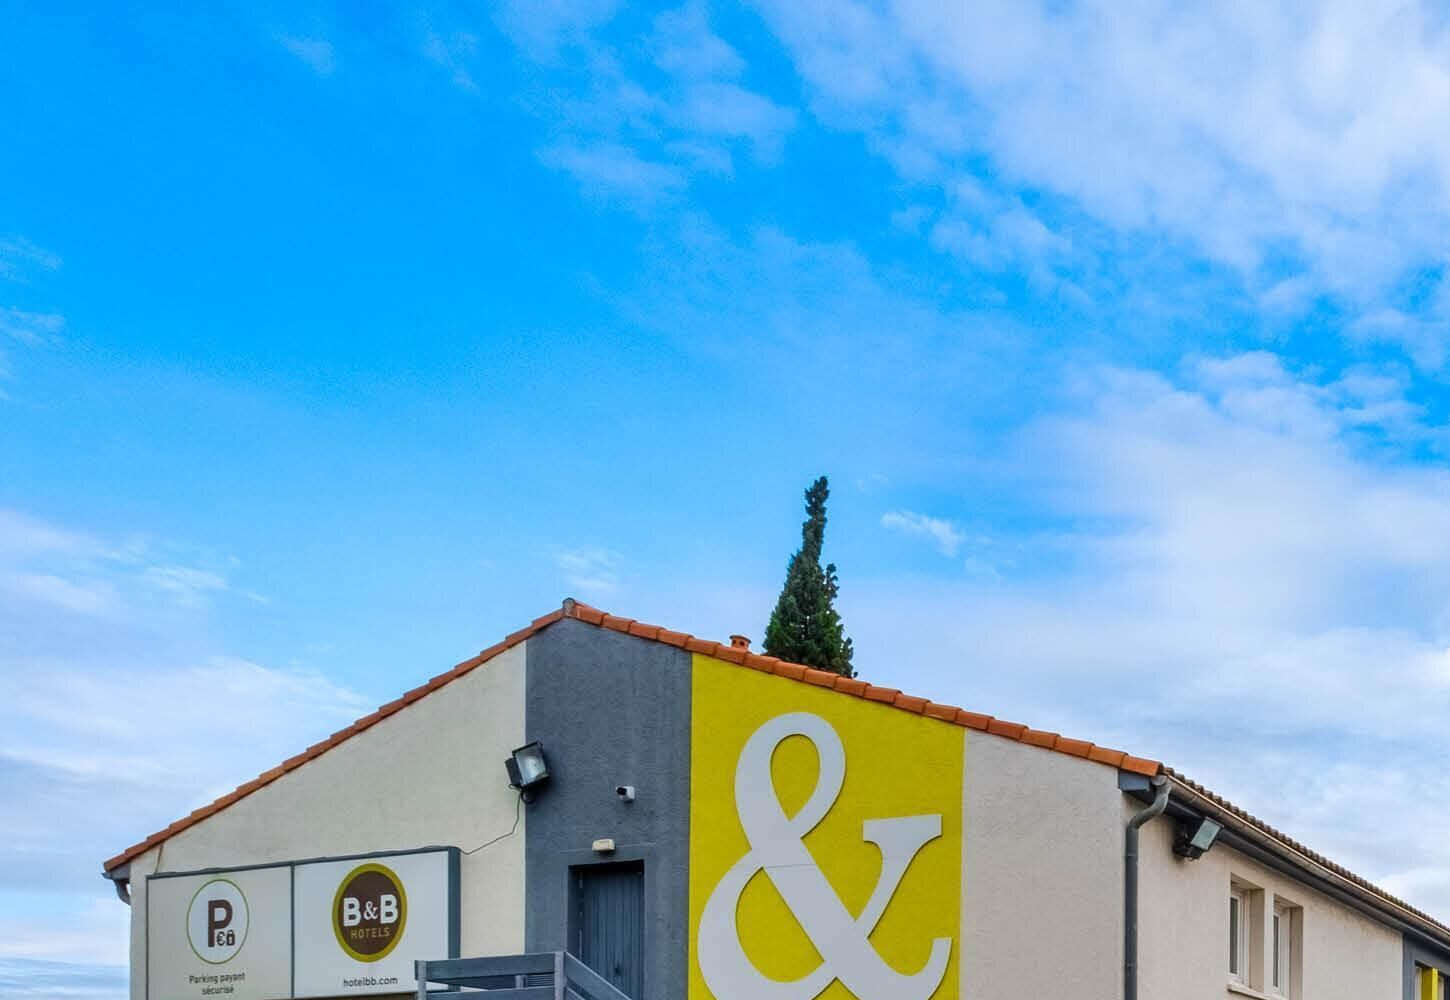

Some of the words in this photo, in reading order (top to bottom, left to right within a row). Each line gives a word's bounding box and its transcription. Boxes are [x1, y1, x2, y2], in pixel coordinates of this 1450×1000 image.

[343, 894, 399, 927] B&B
[350, 927, 391, 940] HOTELS
[188, 973, 218, 985] Parking
[219, 972, 246, 985] payant
[343, 976, 399, 988] hotelbb.com
